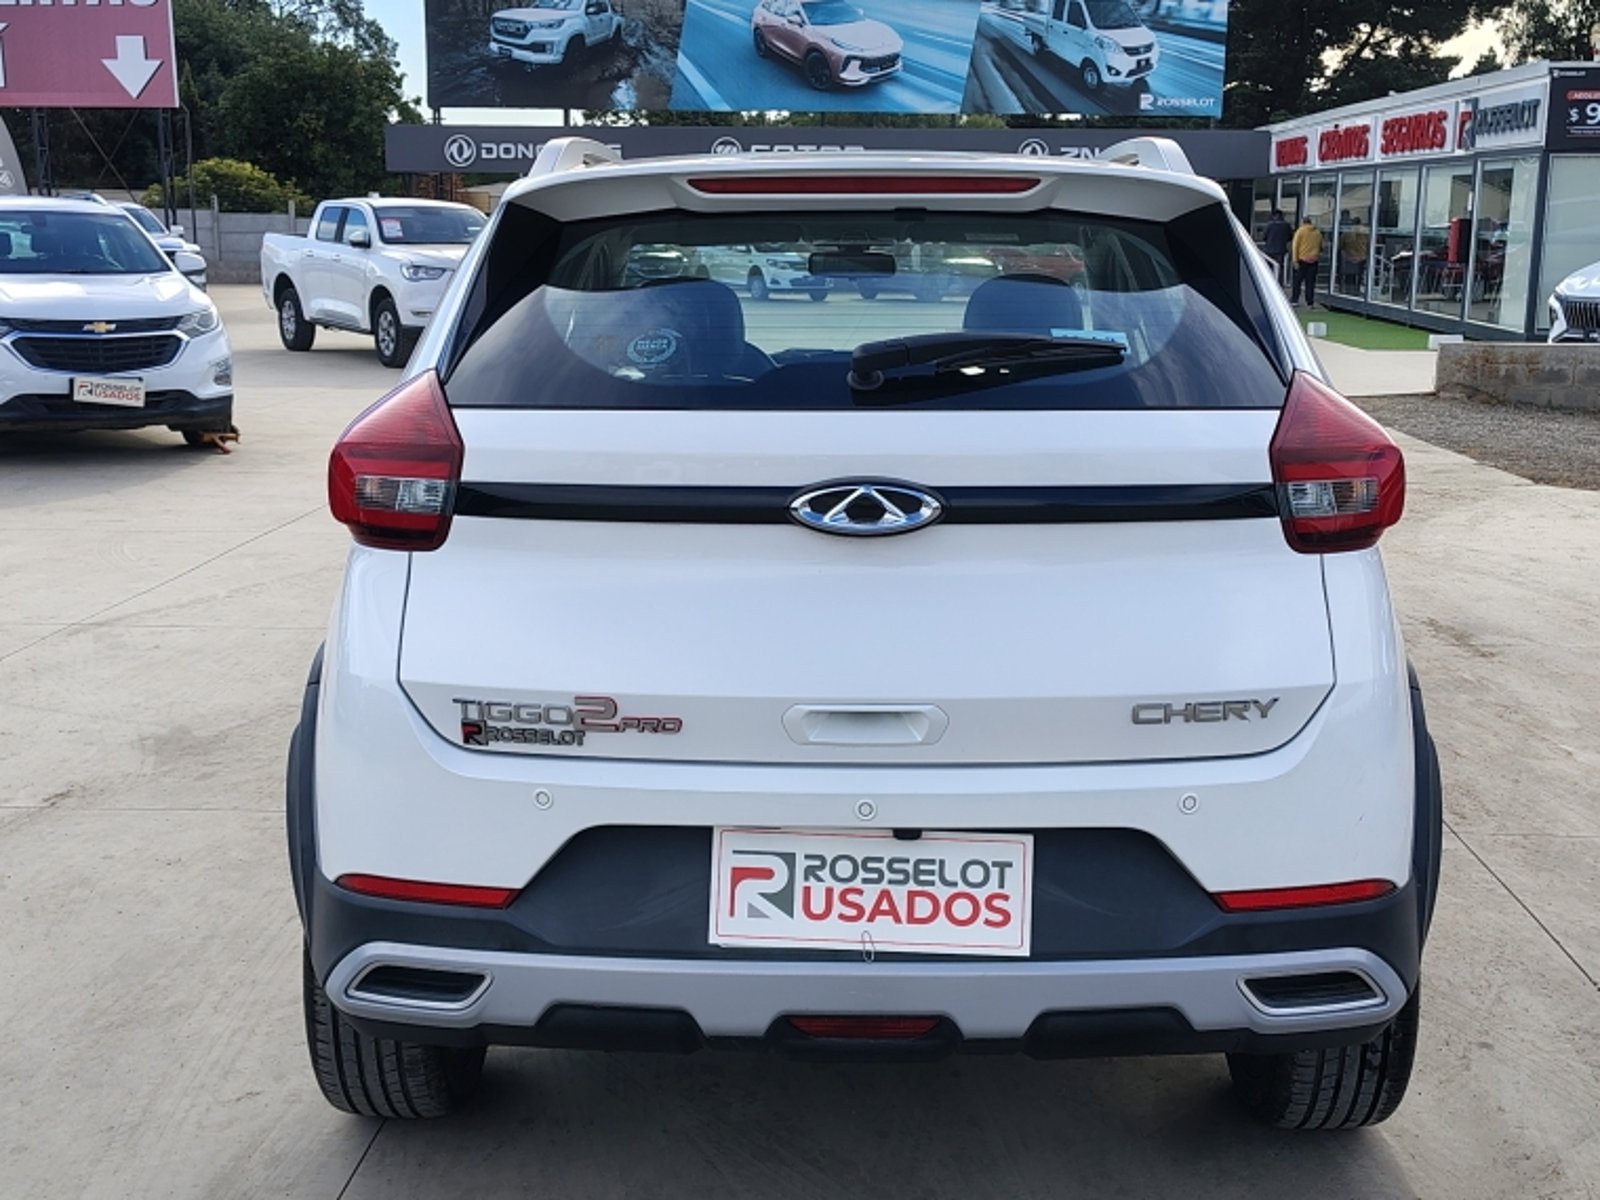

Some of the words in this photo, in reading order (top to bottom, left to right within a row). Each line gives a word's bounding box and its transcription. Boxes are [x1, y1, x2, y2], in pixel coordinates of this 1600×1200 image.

[1132, 696, 1280, 725] CHERY
[486, 726, 586, 747] ROSSELOT
[803, 854, 1013, 889] ROSSELOT
[802, 886, 1012, 929] USADOS
